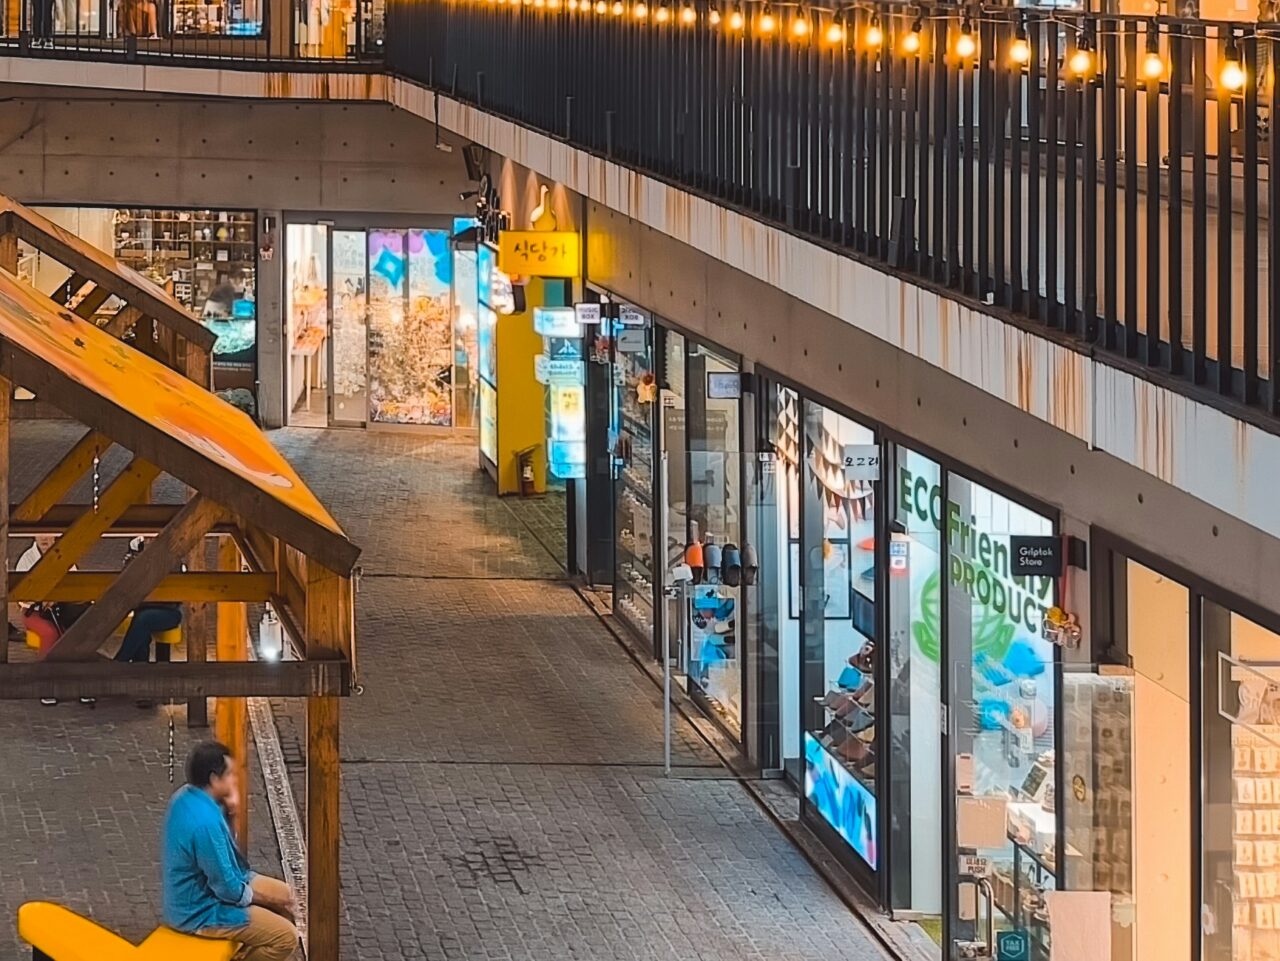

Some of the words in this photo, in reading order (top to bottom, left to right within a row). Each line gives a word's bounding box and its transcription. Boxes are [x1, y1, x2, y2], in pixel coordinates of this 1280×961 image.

[514, 240, 567, 262] 식당가
[1020, 546, 1053, 558] Griptok
[1020, 557, 1043, 566] Store
